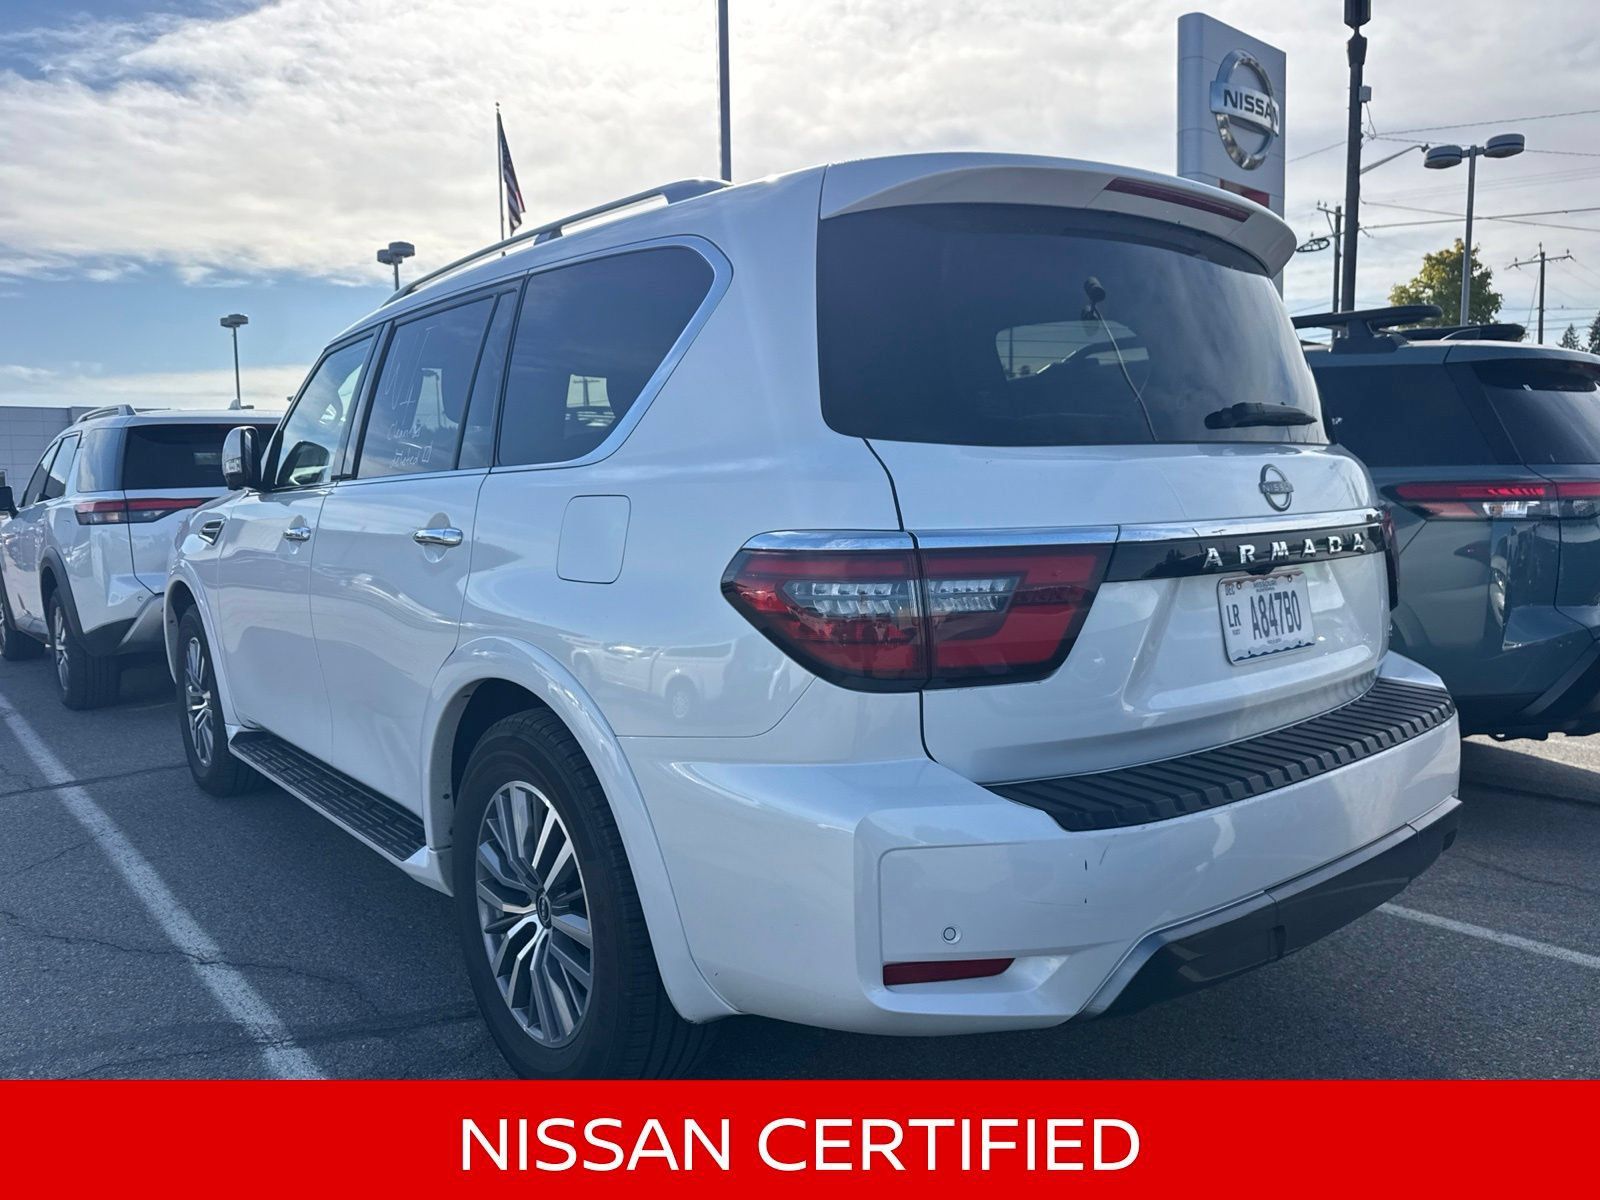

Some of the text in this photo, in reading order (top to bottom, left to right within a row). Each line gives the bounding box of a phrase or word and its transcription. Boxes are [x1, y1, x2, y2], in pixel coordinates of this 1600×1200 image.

[1223, 89, 1279, 125] NISSAN
[1203, 533, 1366, 568] ARMADA
[1226, 604, 1241, 628] LR
